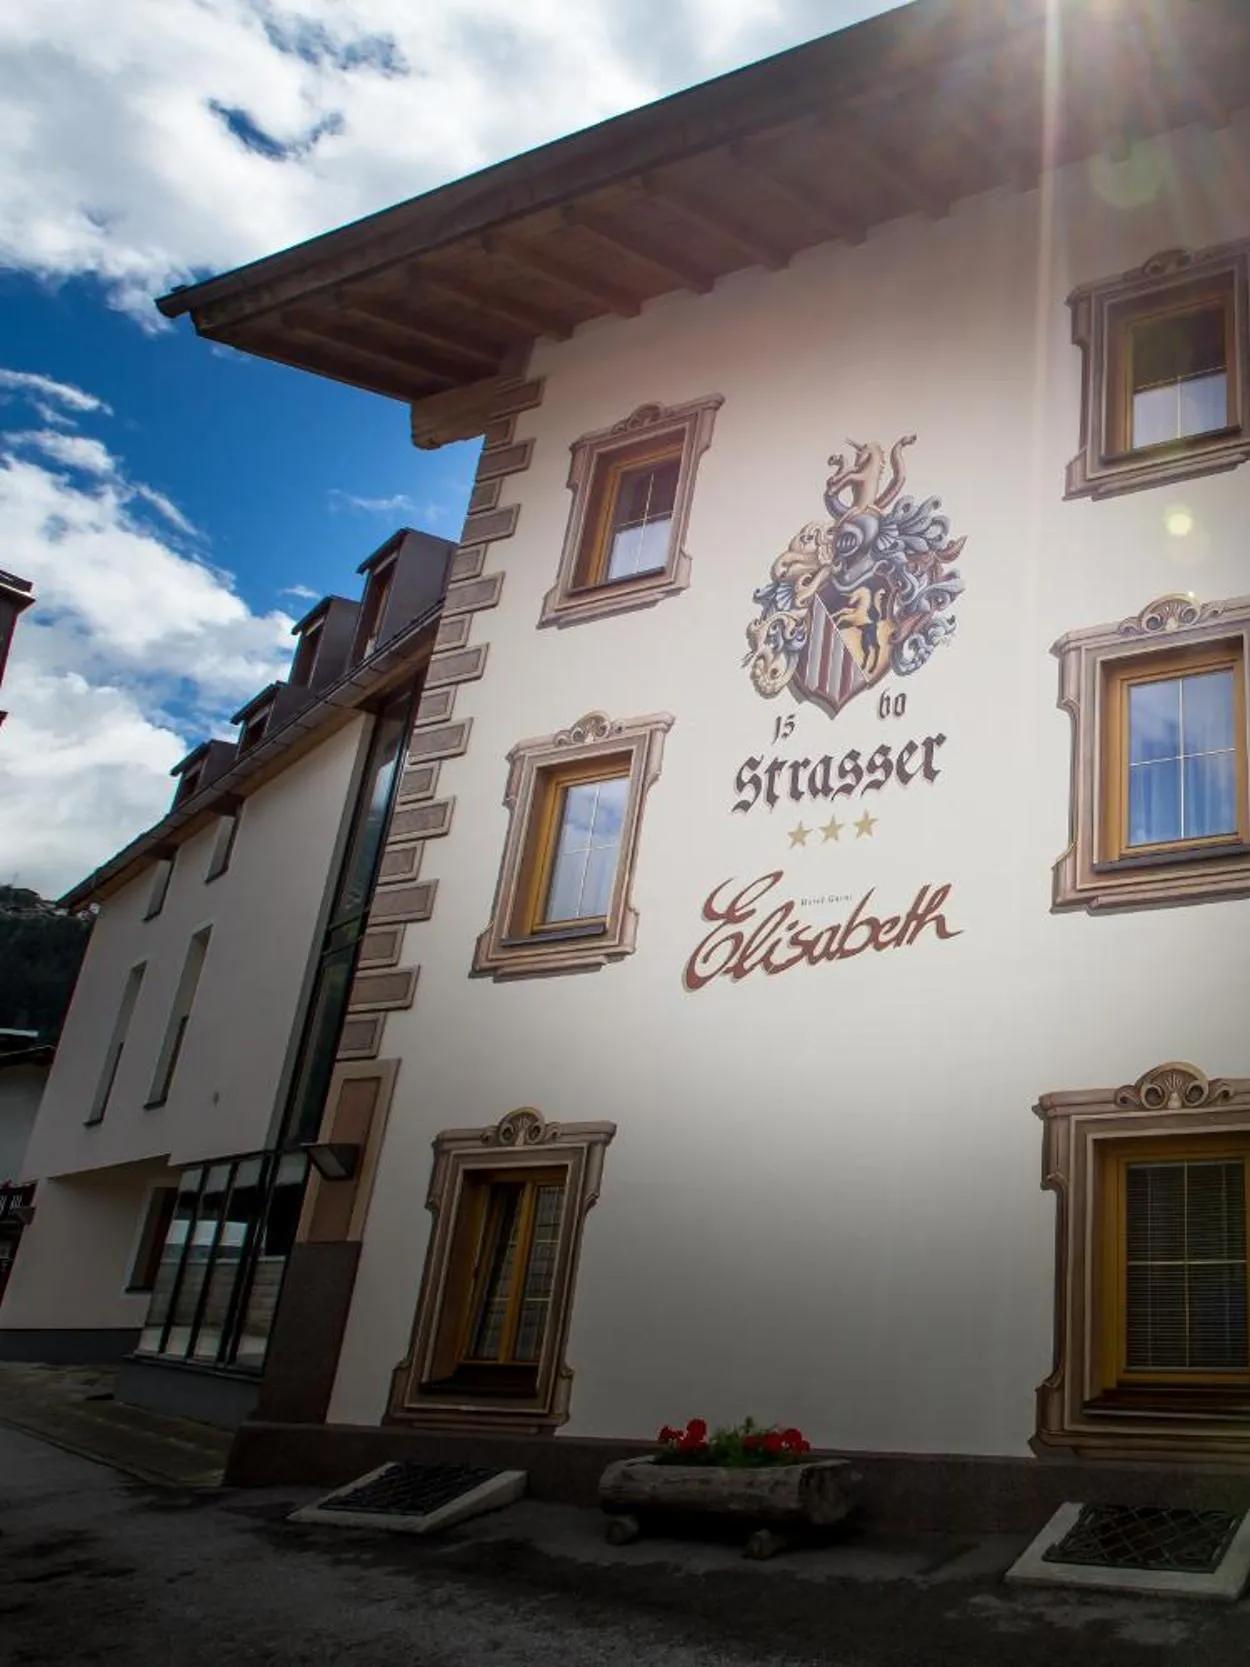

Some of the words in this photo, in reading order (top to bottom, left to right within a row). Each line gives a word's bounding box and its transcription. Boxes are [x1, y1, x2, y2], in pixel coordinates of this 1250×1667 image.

[772, 713, 796, 745] 15
[877, 688, 907, 719] 60
[682, 870, 964, 992] Elisabeth
